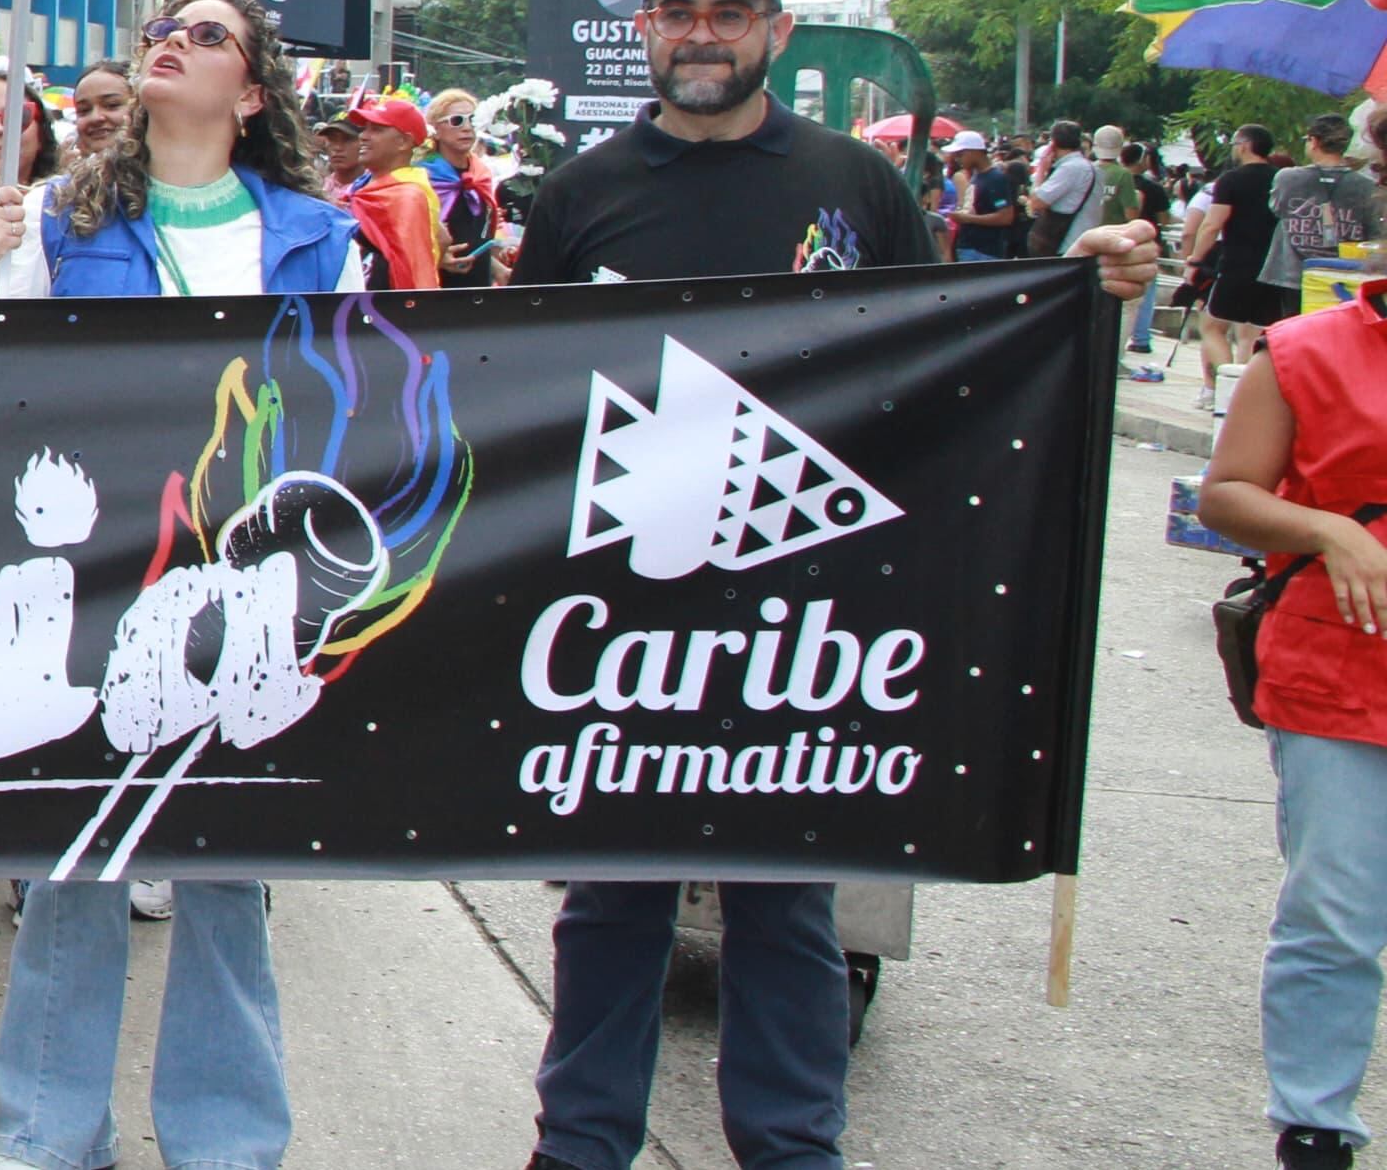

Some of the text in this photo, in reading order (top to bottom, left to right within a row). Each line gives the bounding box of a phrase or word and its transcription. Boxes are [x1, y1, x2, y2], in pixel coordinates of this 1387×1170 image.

[586, 64, 601, 76] 22
[605, 64, 622, 76] DE
[587, 78, 621, 87] Pereira,
[520, 594, 925, 713] Caribe
[519, 722, 922, 817] afirmativo
